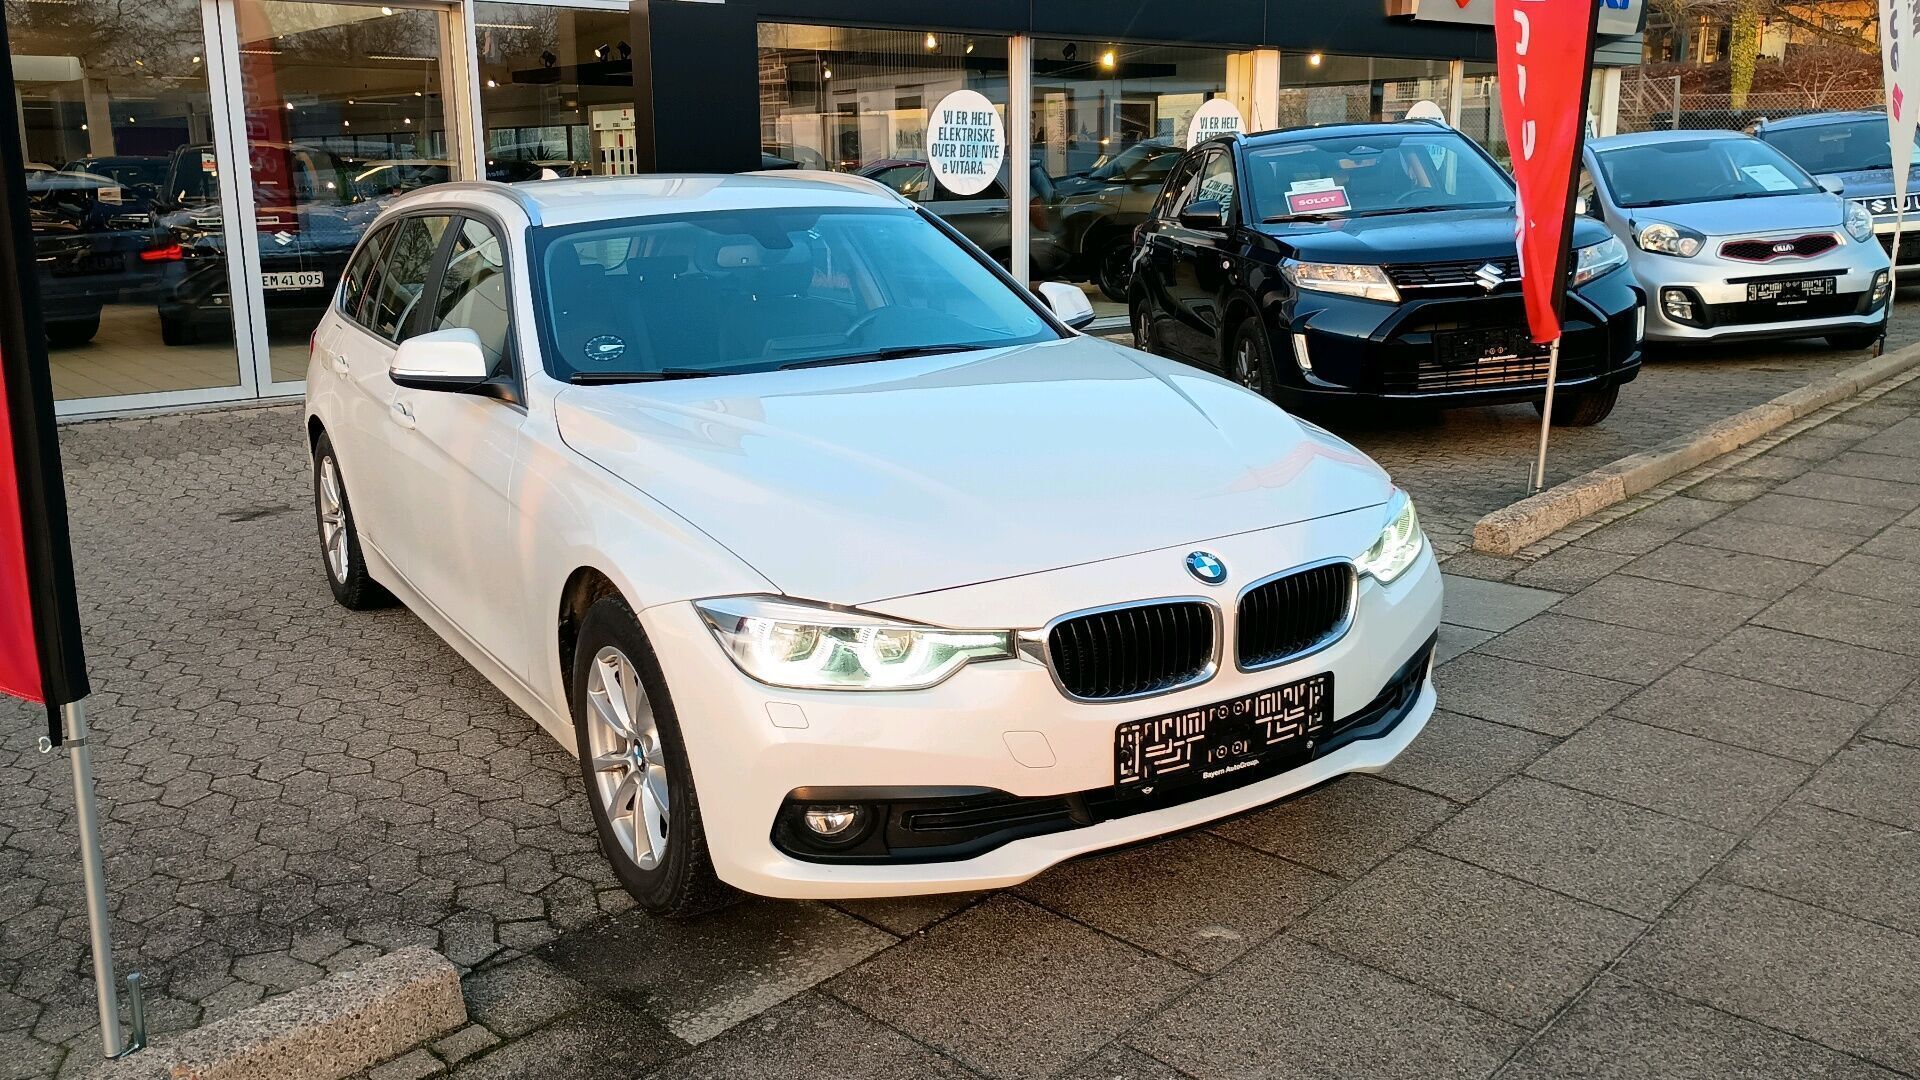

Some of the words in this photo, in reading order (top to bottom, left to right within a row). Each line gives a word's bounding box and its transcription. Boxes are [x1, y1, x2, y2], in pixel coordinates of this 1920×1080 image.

[943, 110, 953, 125] VI
[956, 111, 968, 126] ER
[970, 111, 993, 126] HELT
[1200, 117, 1208, 129] VI
[1210, 117, 1219, 129] ER
[1221, 117, 1238, 129] HELT
[938, 127, 995, 142] ELEKTRISKE
[931, 143, 956, 158] OVER
[959, 144, 978, 158] DEN
[981, 145, 999, 158] NYE
[949, 160, 986, 175] VITARA.
[1298, 196, 1336, 205] SOLGT
[262, 275, 278, 286] EM
[281, 275, 295, 286] 41
[298, 274, 321, 285] 095
[1202, 768, 1225, 779] Bayern
